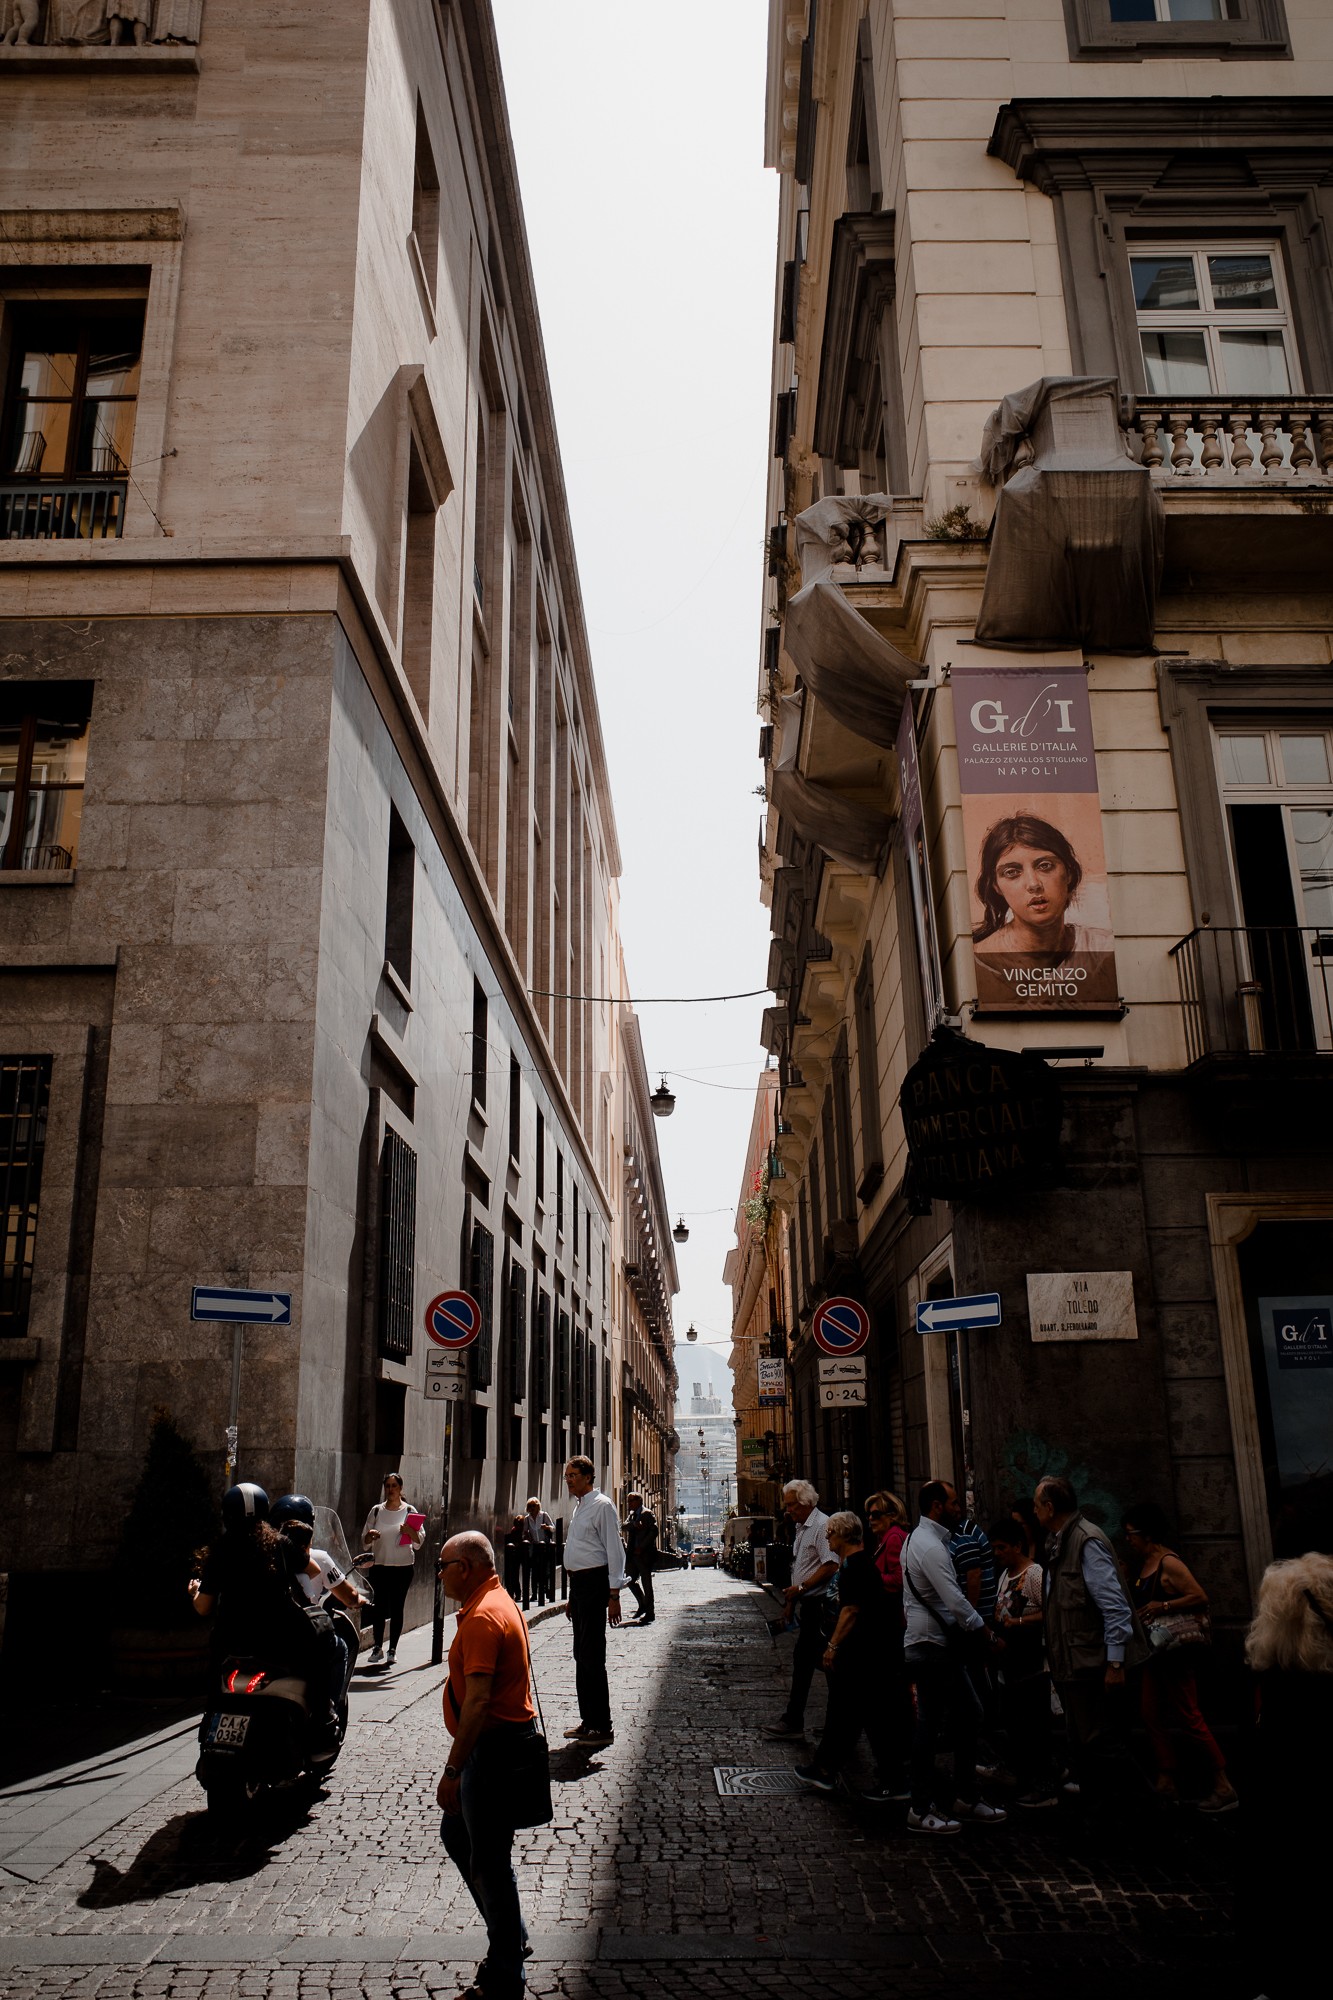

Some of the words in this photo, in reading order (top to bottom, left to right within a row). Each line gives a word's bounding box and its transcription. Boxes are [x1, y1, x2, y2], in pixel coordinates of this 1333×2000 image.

[972, 743, 1027, 752] GALLERIE
[1030, 742, 1078, 751] D'ITALIA
[1003, 756, 1044, 764] ZEVALLOS
[997, 767, 1058, 775] NAPOLI
[1003, 967, 1087, 981] VINCENZO
[1015, 983, 1078, 997] GEMITO
[912, 1063, 1011, 1107] BANCA
[1073, 1281, 1089, 1292] VIA
[1067, 1300, 1099, 1314] TOLEDO
[760, 1358, 782, 1371] Snack
[760, 1370, 774, 1379] Bar
[220, 1716, 235, 1729] CA
[216, 1729, 243, 1743] 0356
